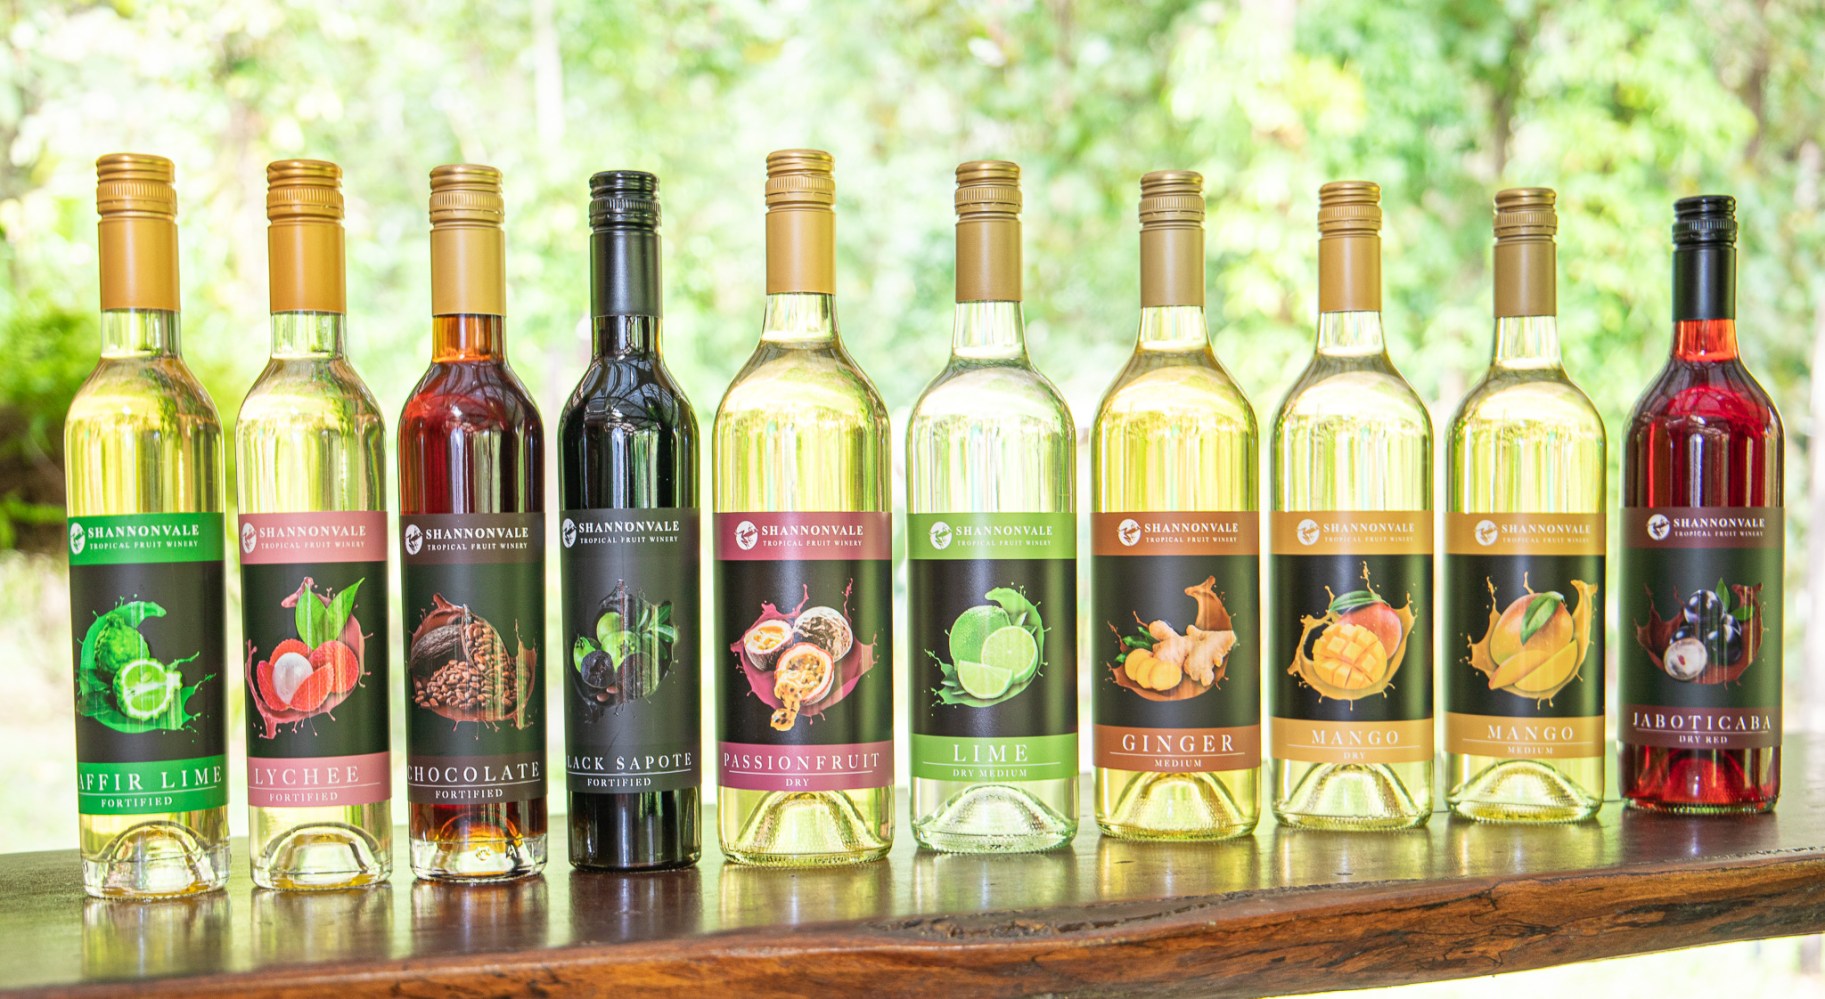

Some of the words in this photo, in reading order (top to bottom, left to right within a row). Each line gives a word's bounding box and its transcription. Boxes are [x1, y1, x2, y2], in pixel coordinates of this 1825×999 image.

[579, 521, 679, 533] SHANNONVALE
[1145, 523, 1239, 533] SHANNONVALE
[1323, 523, 1415, 533] SHANNONVALE
[1501, 524, 1590, 534] SHANNONVALE
[1673, 518, 1765, 528] SHANNONVALE
[88, 524, 199, 538] SHANNONVALE
[259, 526, 366, 538] SHANNONVALE
[426, 528, 529, 540] SHANNONVALE
[761, 525, 864, 536] SHANNONVALE
[956, 526, 1052, 536] SHANNONVALE
[90, 542, 130, 550] TROPICAL
[134, 541, 162, 549] FRUIT
[166, 540, 198, 548] WINERY
[1633, 712, 1771, 730] JABOTICABA
[1312, 729, 1399, 745] MANGO
[1488, 724, 1573, 740] MANGO
[1122, 734, 1234, 752] GINGER
[953, 744, 1028, 762] LIME
[1508, 746, 1553, 754] MEDIUM
[567, 755, 604, 770] LACK
[616, 752, 691, 770] SAPOTE
[724, 752, 879, 770] PASSIONFRUIT
[1155, 759, 1202, 767] MEDIUM
[80, 773, 143, 790] AFFIR
[161, 766, 222, 789] LIME
[255, 766, 359, 785] LYCHEE
[408, 762, 539, 782] CHOCOLATE
[953, 769, 974, 777] DRY
[979, 769, 1027, 777] MEDIUM
[587, 778, 651, 787] FORTIFIED
[269, 792, 338, 802] FORTIFIED
[436, 789, 503, 799] FORTIFIED
[101, 796, 173, 808] FORTIFIED
